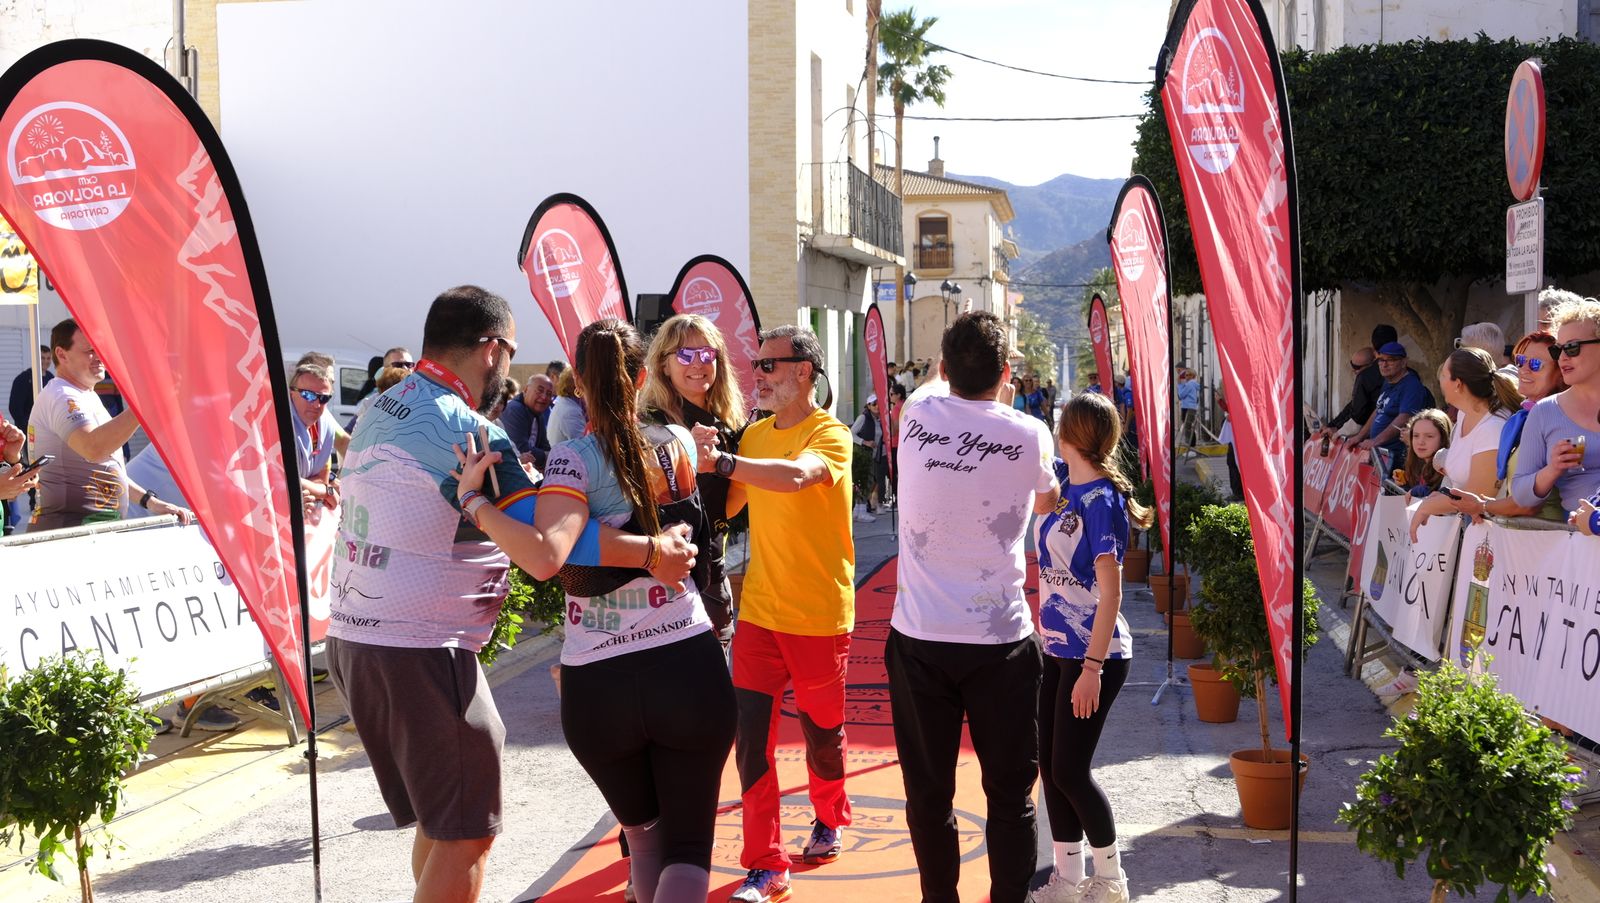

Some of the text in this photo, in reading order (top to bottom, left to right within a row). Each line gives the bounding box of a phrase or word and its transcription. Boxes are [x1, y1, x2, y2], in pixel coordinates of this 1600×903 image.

[374, 395, 411, 420] EMILIO
[903, 419, 1024, 461] Pepe Yepes
[549, 458, 570, 466] LOS
[925, 458, 977, 474] speaker
[14, 565, 205, 617] AYUNTAMIENTO
[630, 616, 695, 641] FERNÁNDEZ
